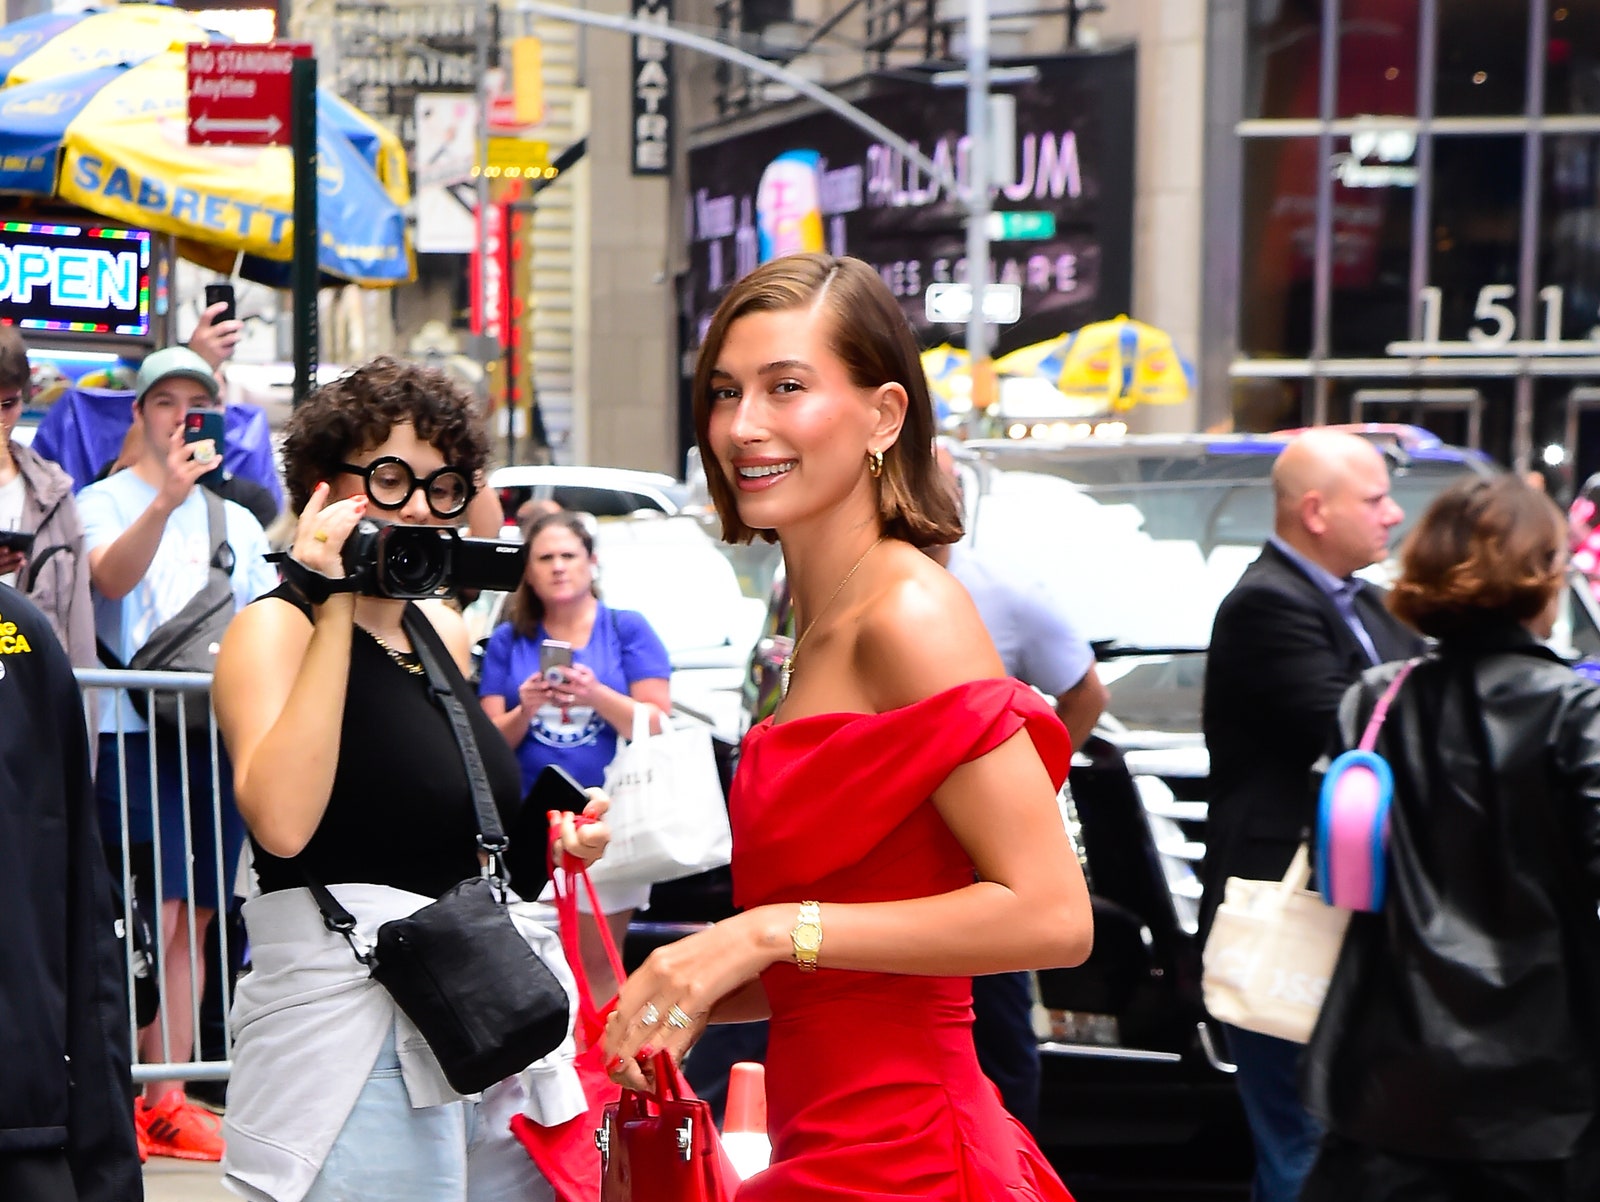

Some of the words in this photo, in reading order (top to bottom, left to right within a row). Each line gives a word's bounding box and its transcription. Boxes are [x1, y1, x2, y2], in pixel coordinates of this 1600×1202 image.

[191, 50, 214, 74] NO
[217, 50, 293, 75] STANDING
[193, 75, 257, 102] Anytime
[636, 0, 669, 170] HEATRE
[74, 154, 293, 245] SABRETT
[867, 130, 1082, 206] PALLAUM
[0, 243, 138, 311] PEN
[933, 254, 1078, 293] SQARE
[1418, 284, 1600, 347] 151
